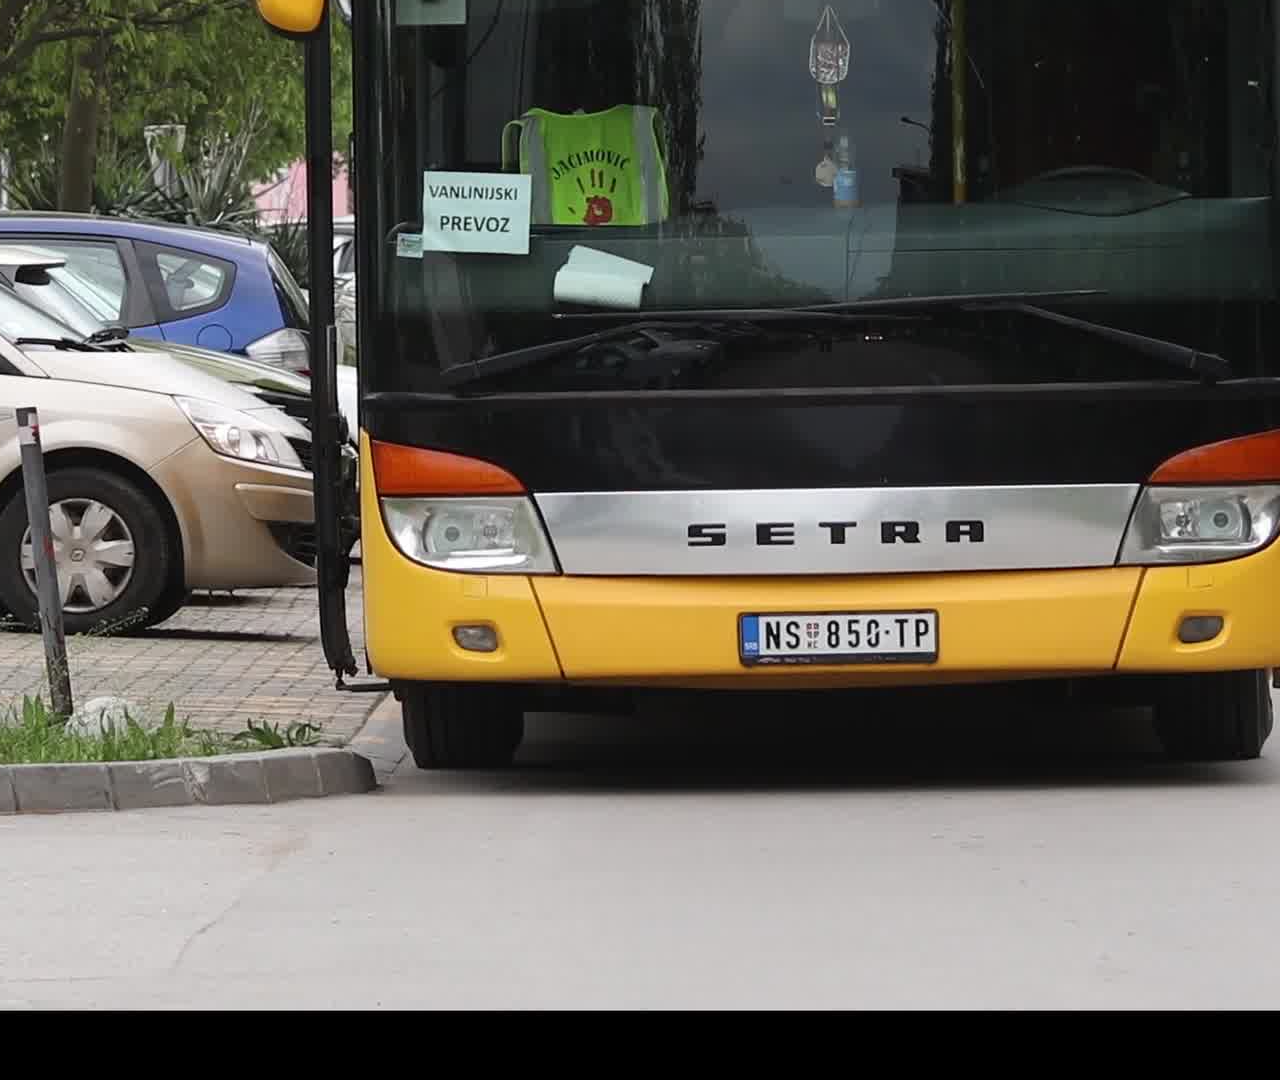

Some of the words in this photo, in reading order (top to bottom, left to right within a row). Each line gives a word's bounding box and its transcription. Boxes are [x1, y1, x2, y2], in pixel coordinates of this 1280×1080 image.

[429, 185, 518, 201] VANLINIJSKI
[440, 215, 511, 233] PREVOZ
[687, 520, 984, 547] SETRA
[765, 621, 800, 650] NS
